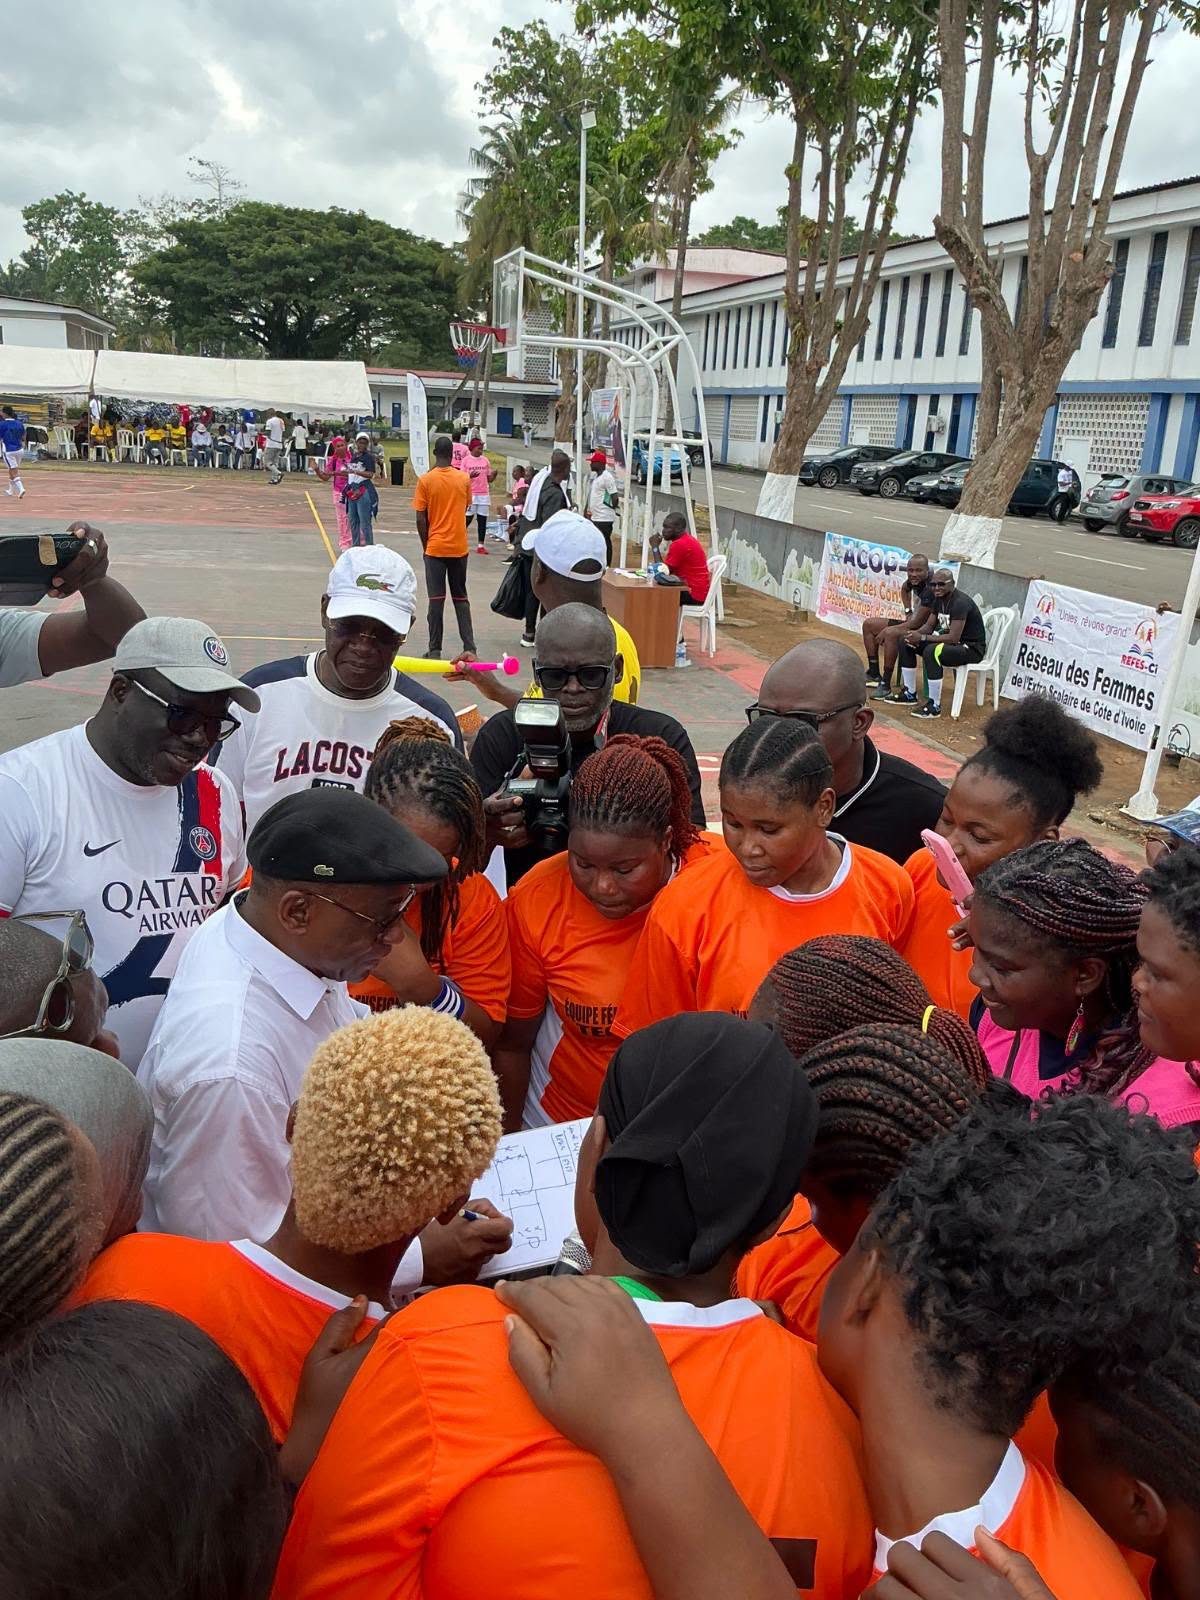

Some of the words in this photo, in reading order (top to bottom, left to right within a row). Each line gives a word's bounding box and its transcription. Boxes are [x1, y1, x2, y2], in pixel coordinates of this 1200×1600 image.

[843, 543, 908, 575] ACOP-
[1016, 643, 1065, 678] Réseau
[1066, 659, 1089, 687] des
[1093, 667, 1155, 711] Femmes
[1011, 673, 1023, 687] de
[1049, 684, 1078, 708] Scolaire
[1080, 699, 1091, 713] de
[1093, 700, 1112, 721] Côte
[1113, 708, 1146, 735] d'Ivoire
[102, 877, 217, 919] QATAR
[565, 998, 599, 1025] ÉQUIPE
